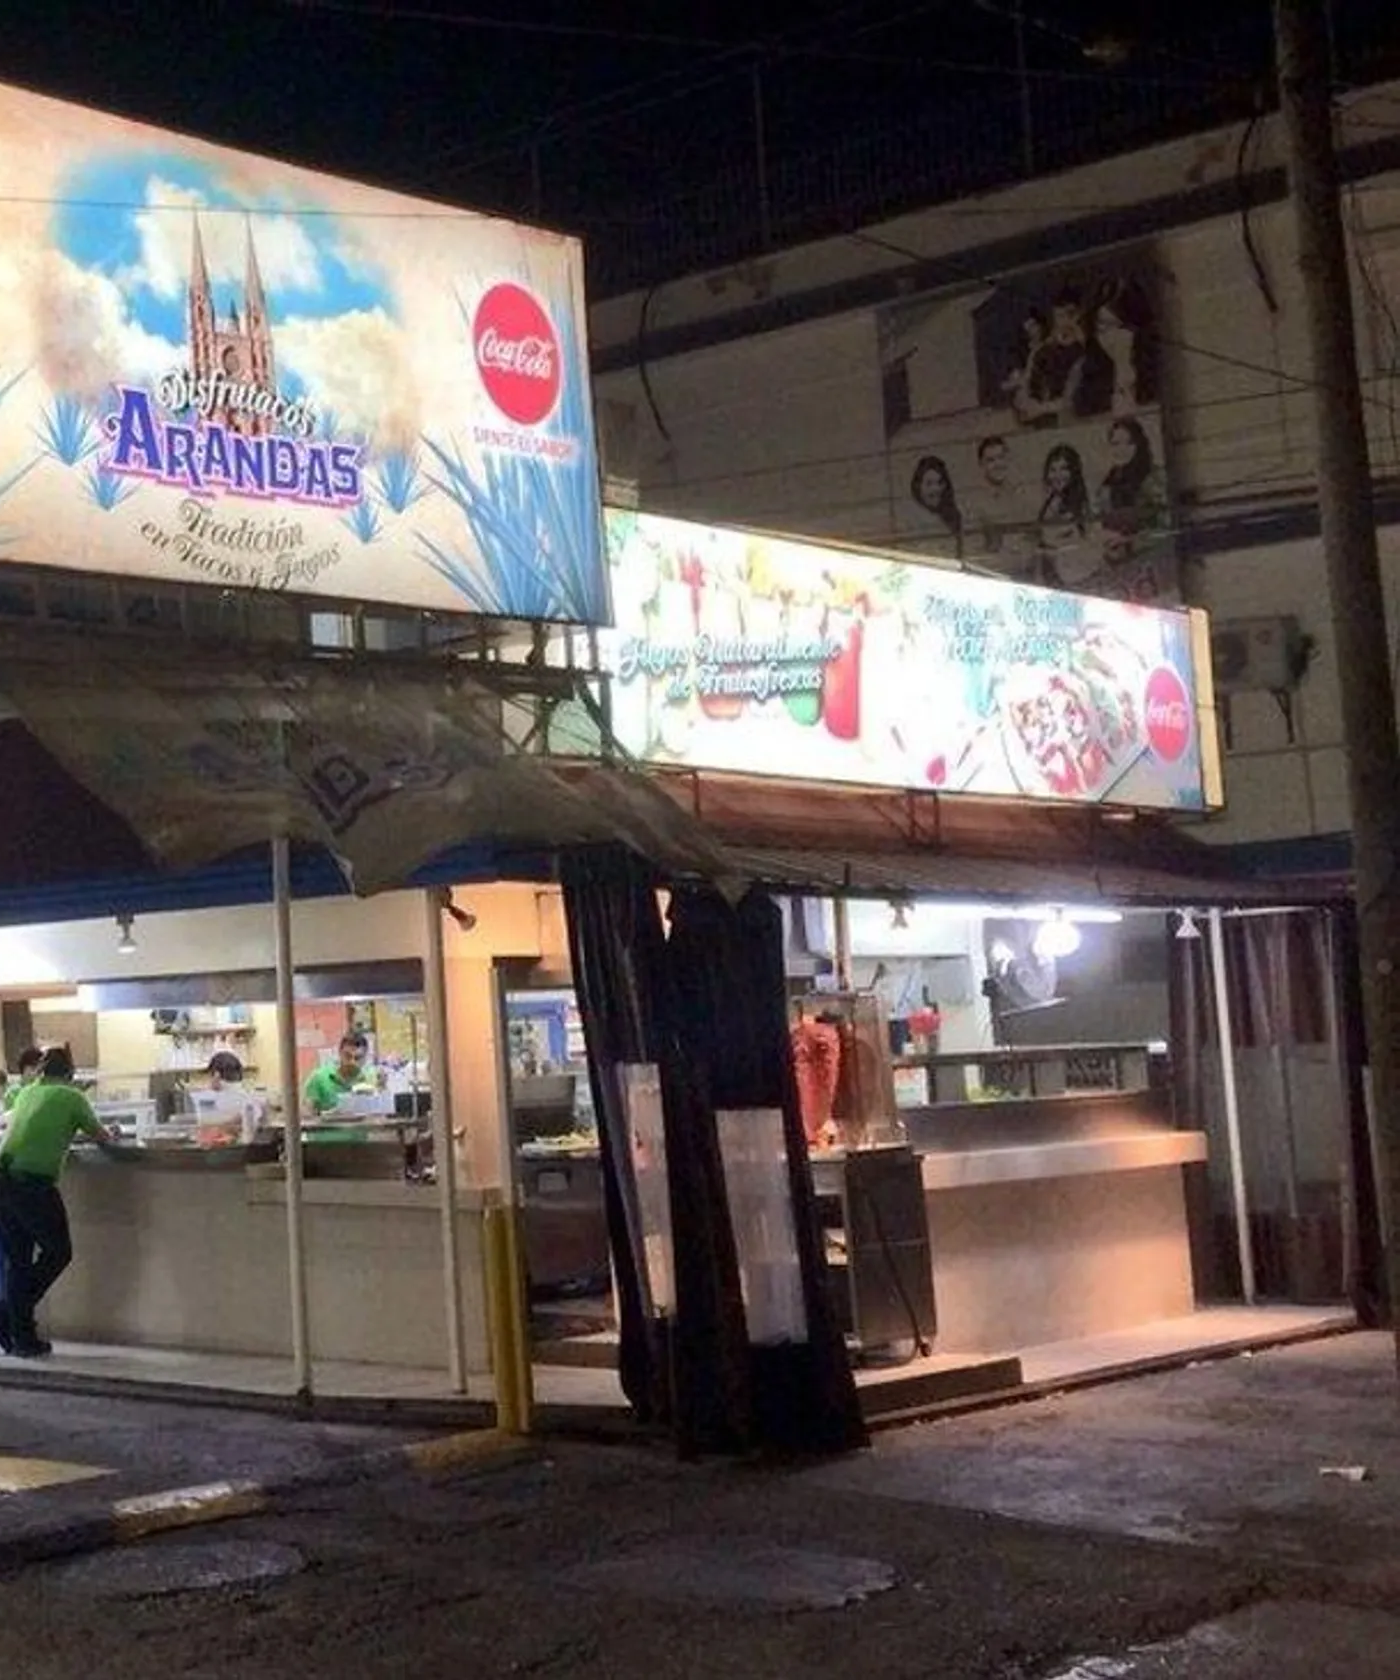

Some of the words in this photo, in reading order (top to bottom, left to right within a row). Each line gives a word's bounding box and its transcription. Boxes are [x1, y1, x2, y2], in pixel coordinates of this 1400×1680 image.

[105, 384, 365, 503] ARANDAS
[141, 520, 171, 549] en
[172, 531, 242, 582] Tacos
[178, 497, 305, 553] Tradición
